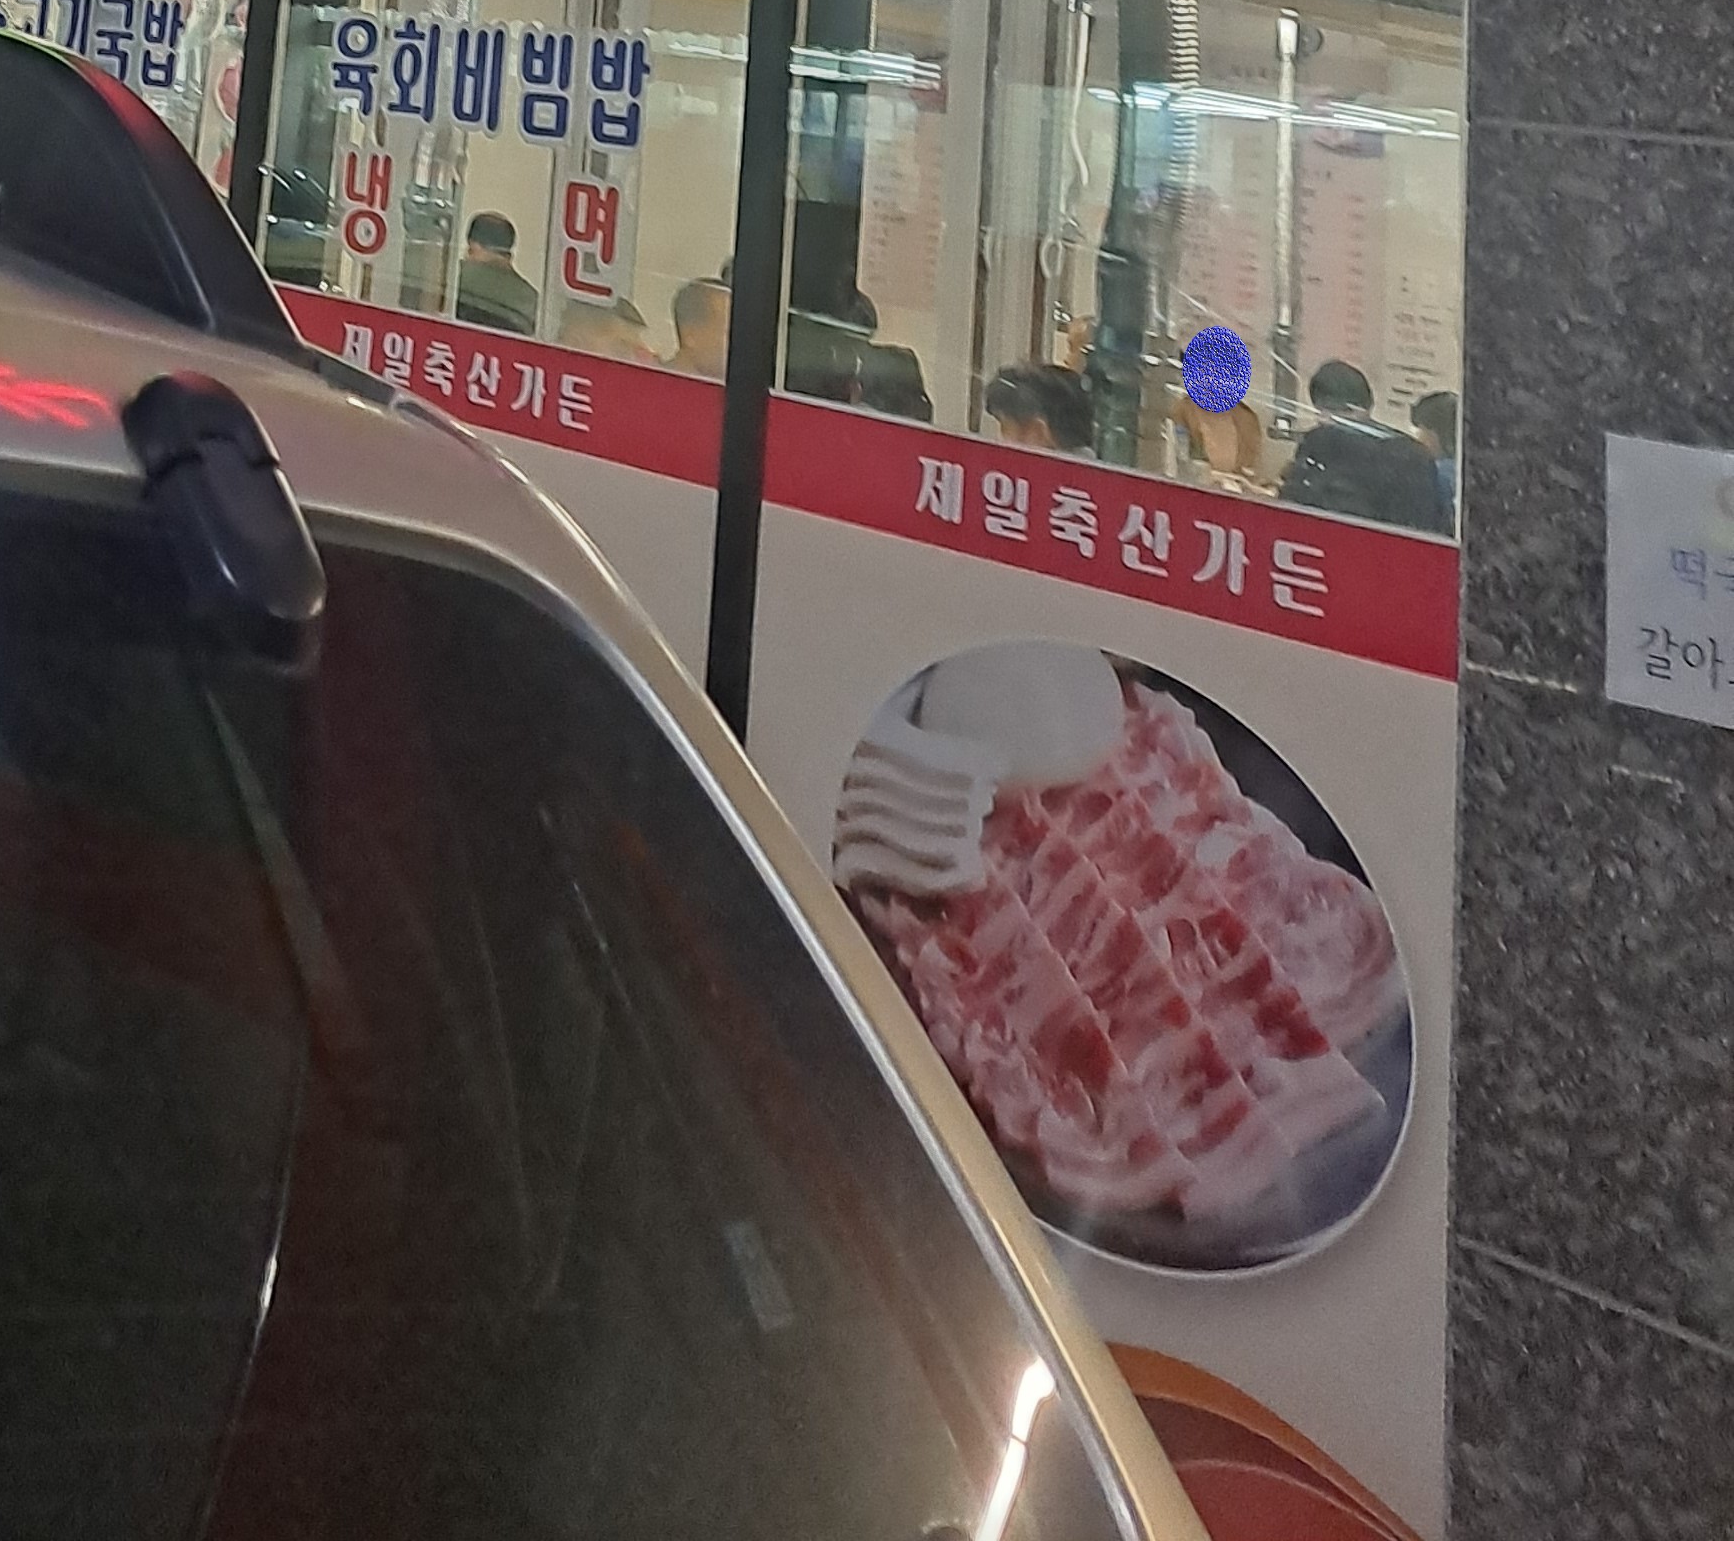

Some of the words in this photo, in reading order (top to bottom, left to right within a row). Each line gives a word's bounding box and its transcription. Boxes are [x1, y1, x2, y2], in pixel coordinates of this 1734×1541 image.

[332, 18, 649, 148] 육회비빔밥
[915, 455, 1329, 618] 제일축산가든
[1639, 625, 1734, 689] 갈아
